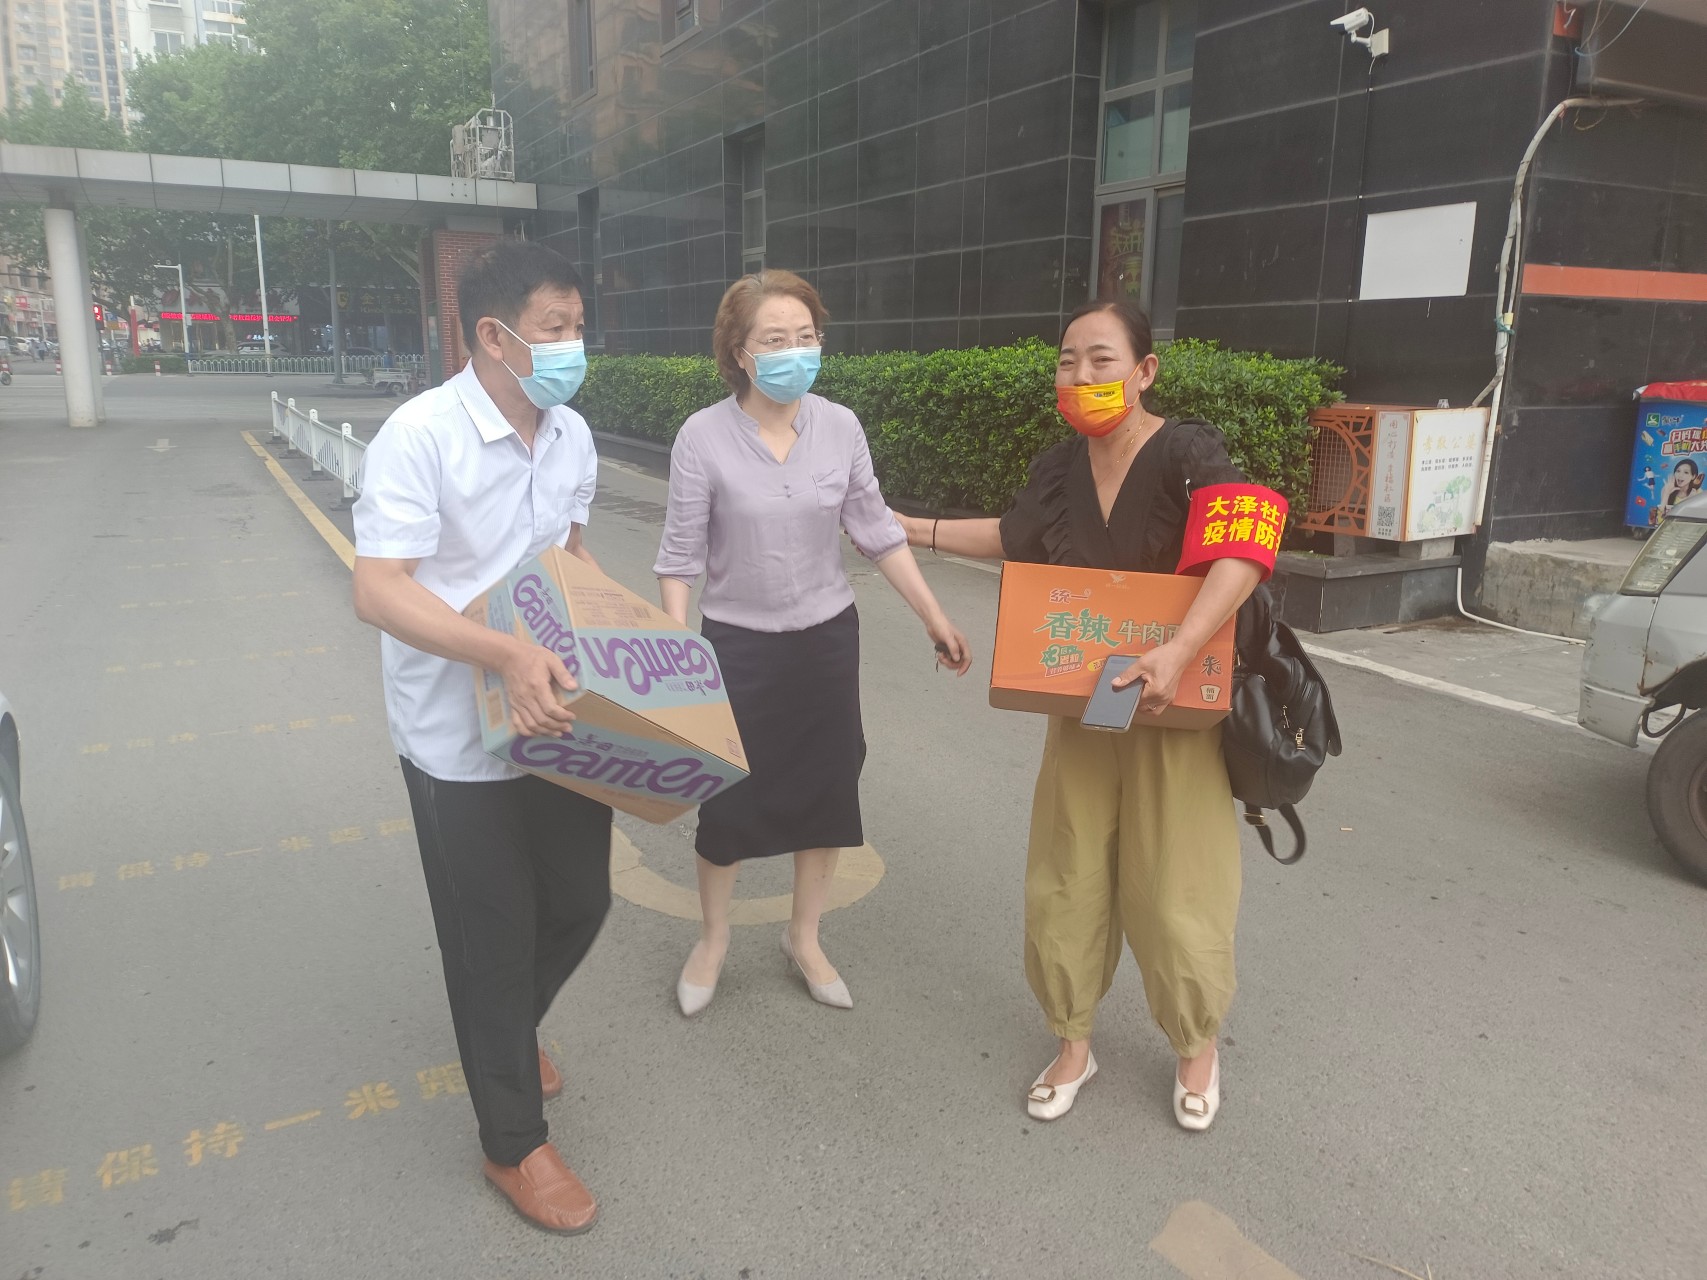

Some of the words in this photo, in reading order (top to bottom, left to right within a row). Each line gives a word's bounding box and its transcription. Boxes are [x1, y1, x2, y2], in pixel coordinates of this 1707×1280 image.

[1206, 496, 1286, 533] 大泽社
[1202, 517, 1281, 557] 疫情防
[1049, 588, 1089, 604] 统一
[580, 637, 721, 695] Ganten
[510, 731, 724, 800] Ganten
